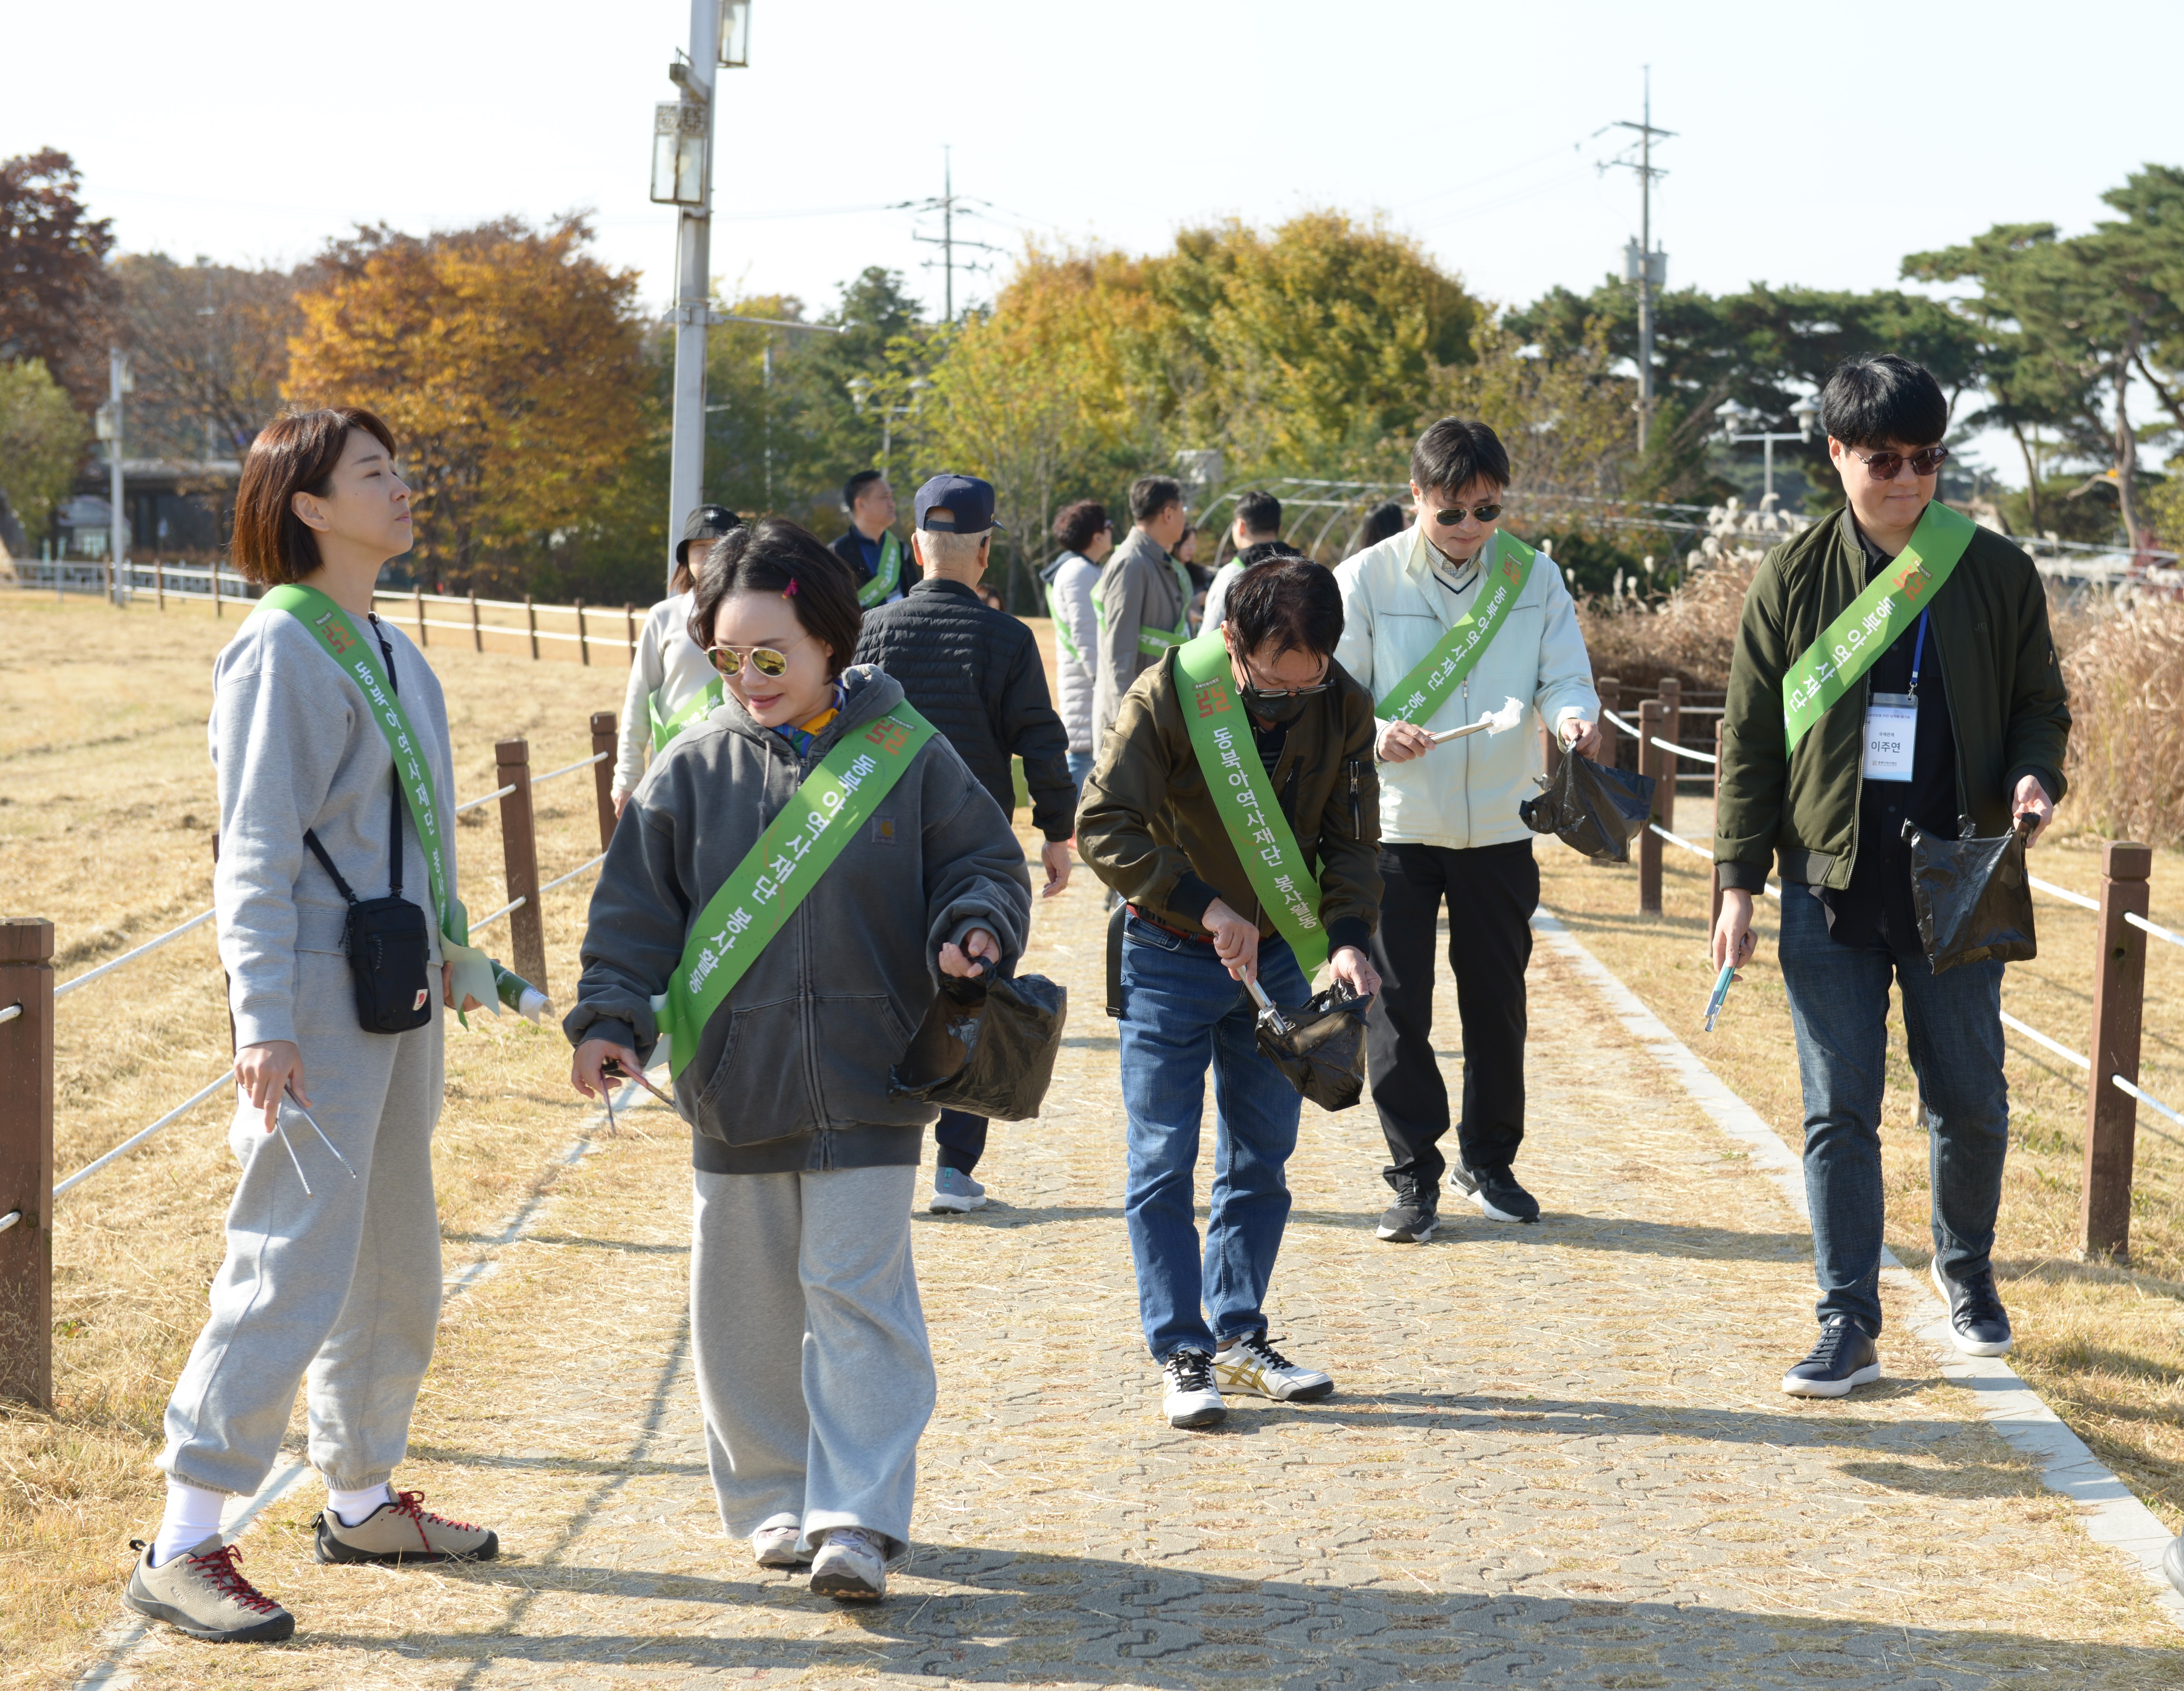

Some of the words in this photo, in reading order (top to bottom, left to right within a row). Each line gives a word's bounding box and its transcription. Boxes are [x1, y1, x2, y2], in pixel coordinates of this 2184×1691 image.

[1195, 678, 1219, 689] 동북아역사재단
[1427, 586, 1507, 691] 동북아역사재단
[1789, 596, 1896, 713] 동북아역사재단
[354, 661, 435, 836] 동북아역사재단
[1871, 741, 1900, 753] 이주연
[751, 754, 877, 905] 동북아역사재단
[1213, 727, 1283, 867] 동북아역사재단
[1274, 874, 1317, 929] 봉사활동
[689, 906, 753, 994] 봉사활동
